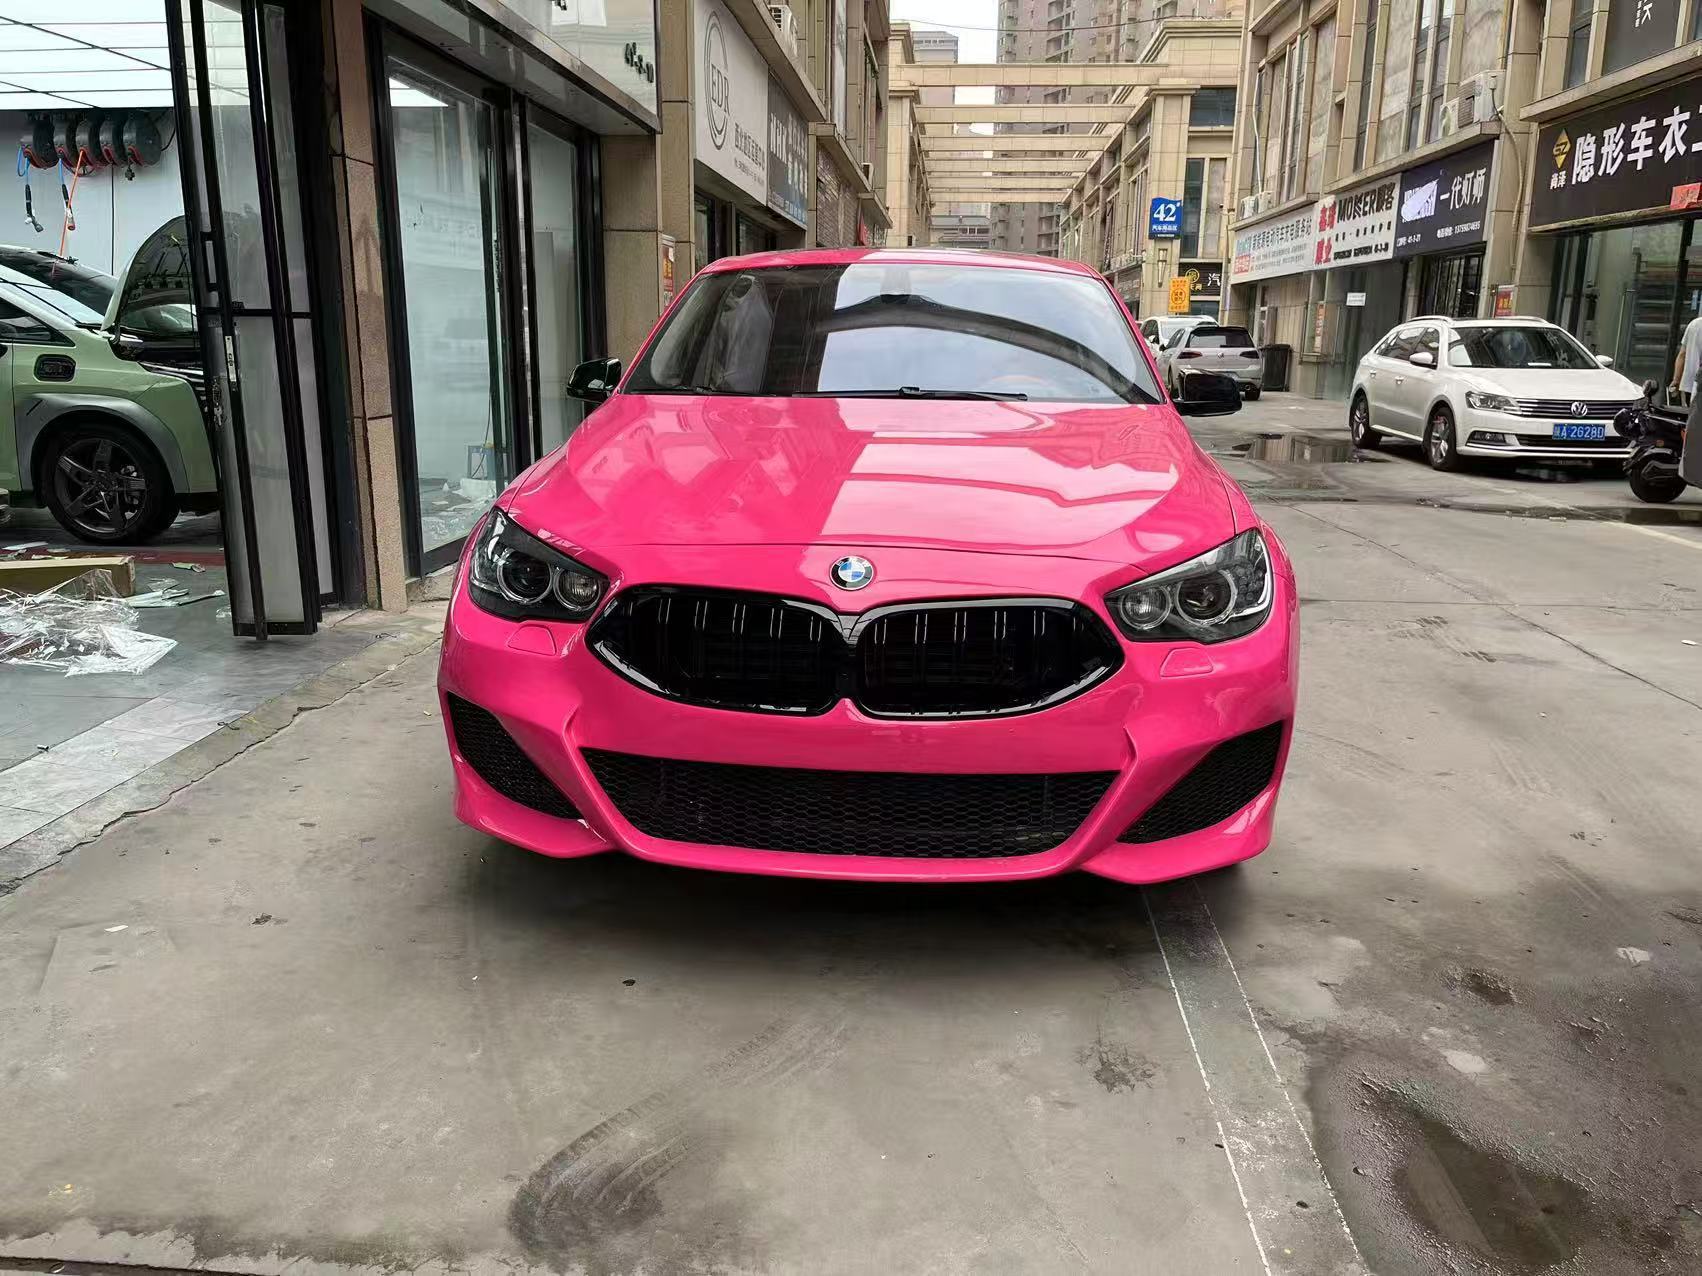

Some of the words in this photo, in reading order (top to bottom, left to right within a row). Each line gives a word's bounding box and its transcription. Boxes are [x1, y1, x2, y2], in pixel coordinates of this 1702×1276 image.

[711, 63, 730, 116] EDR
[1440, 167, 1487, 210] 一代灯师
